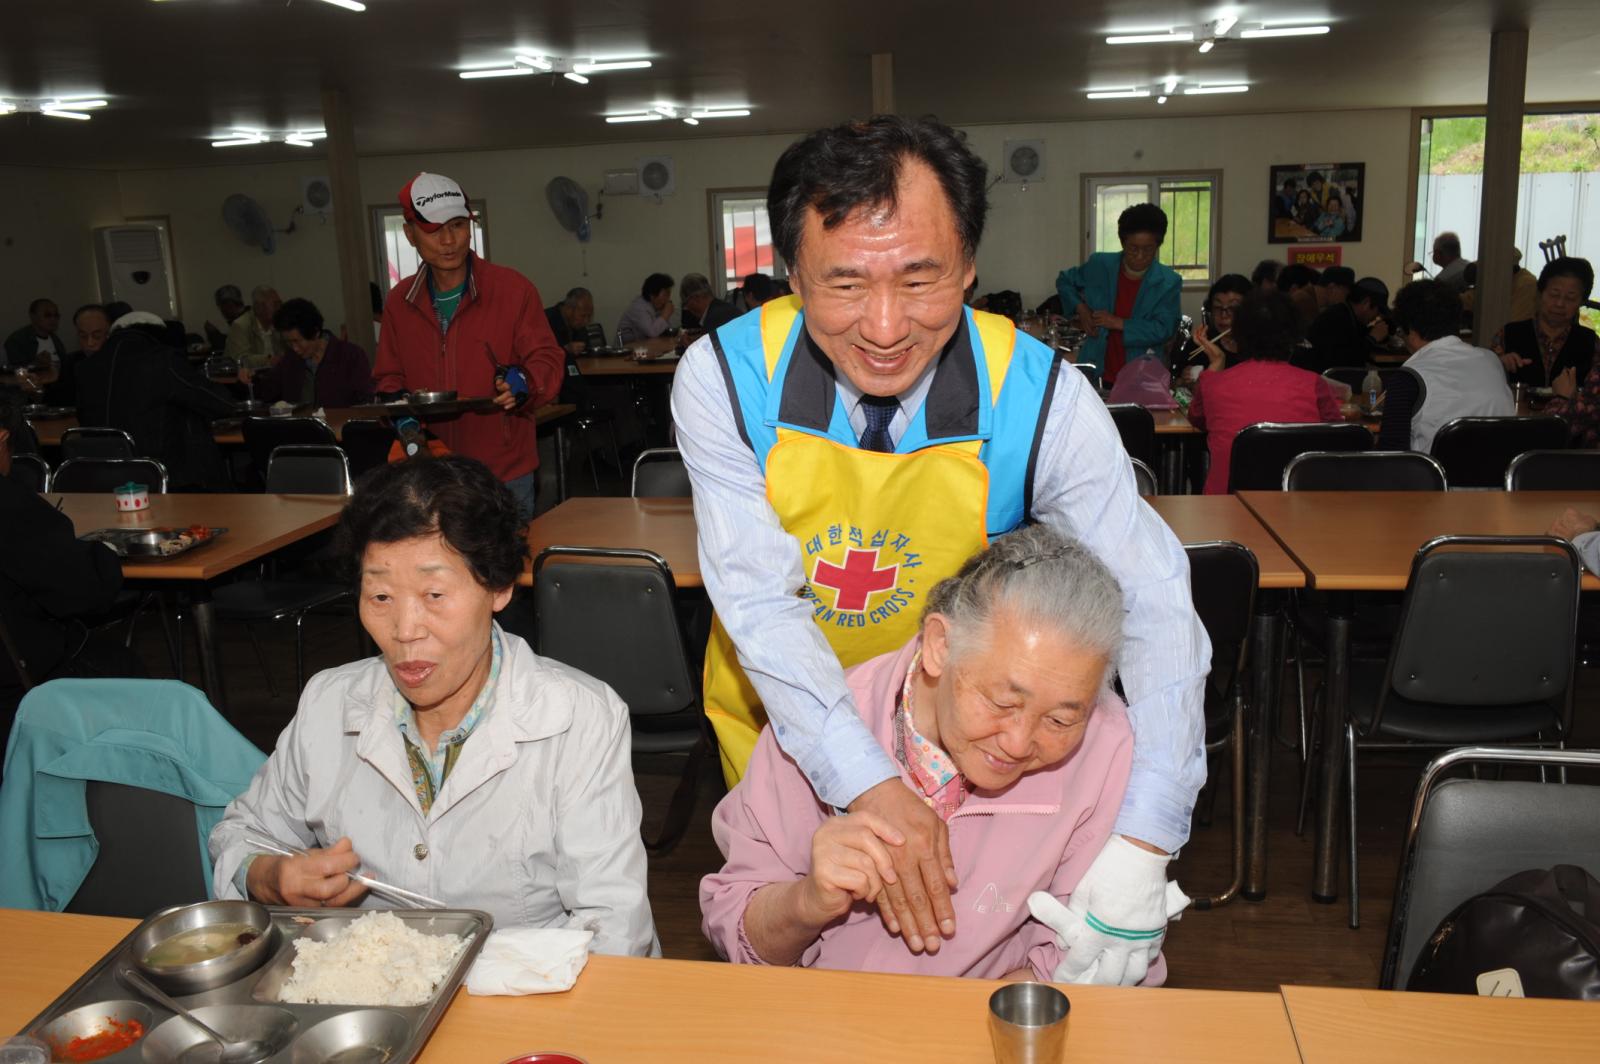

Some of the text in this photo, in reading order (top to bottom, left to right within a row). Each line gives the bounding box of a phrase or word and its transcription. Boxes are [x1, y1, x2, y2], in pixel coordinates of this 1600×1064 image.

[416, 191, 461, 206] TaylorMade
[805, 523, 922, 568] 대한적십자사
[800, 578, 914, 627] OREAN RED CROSS
